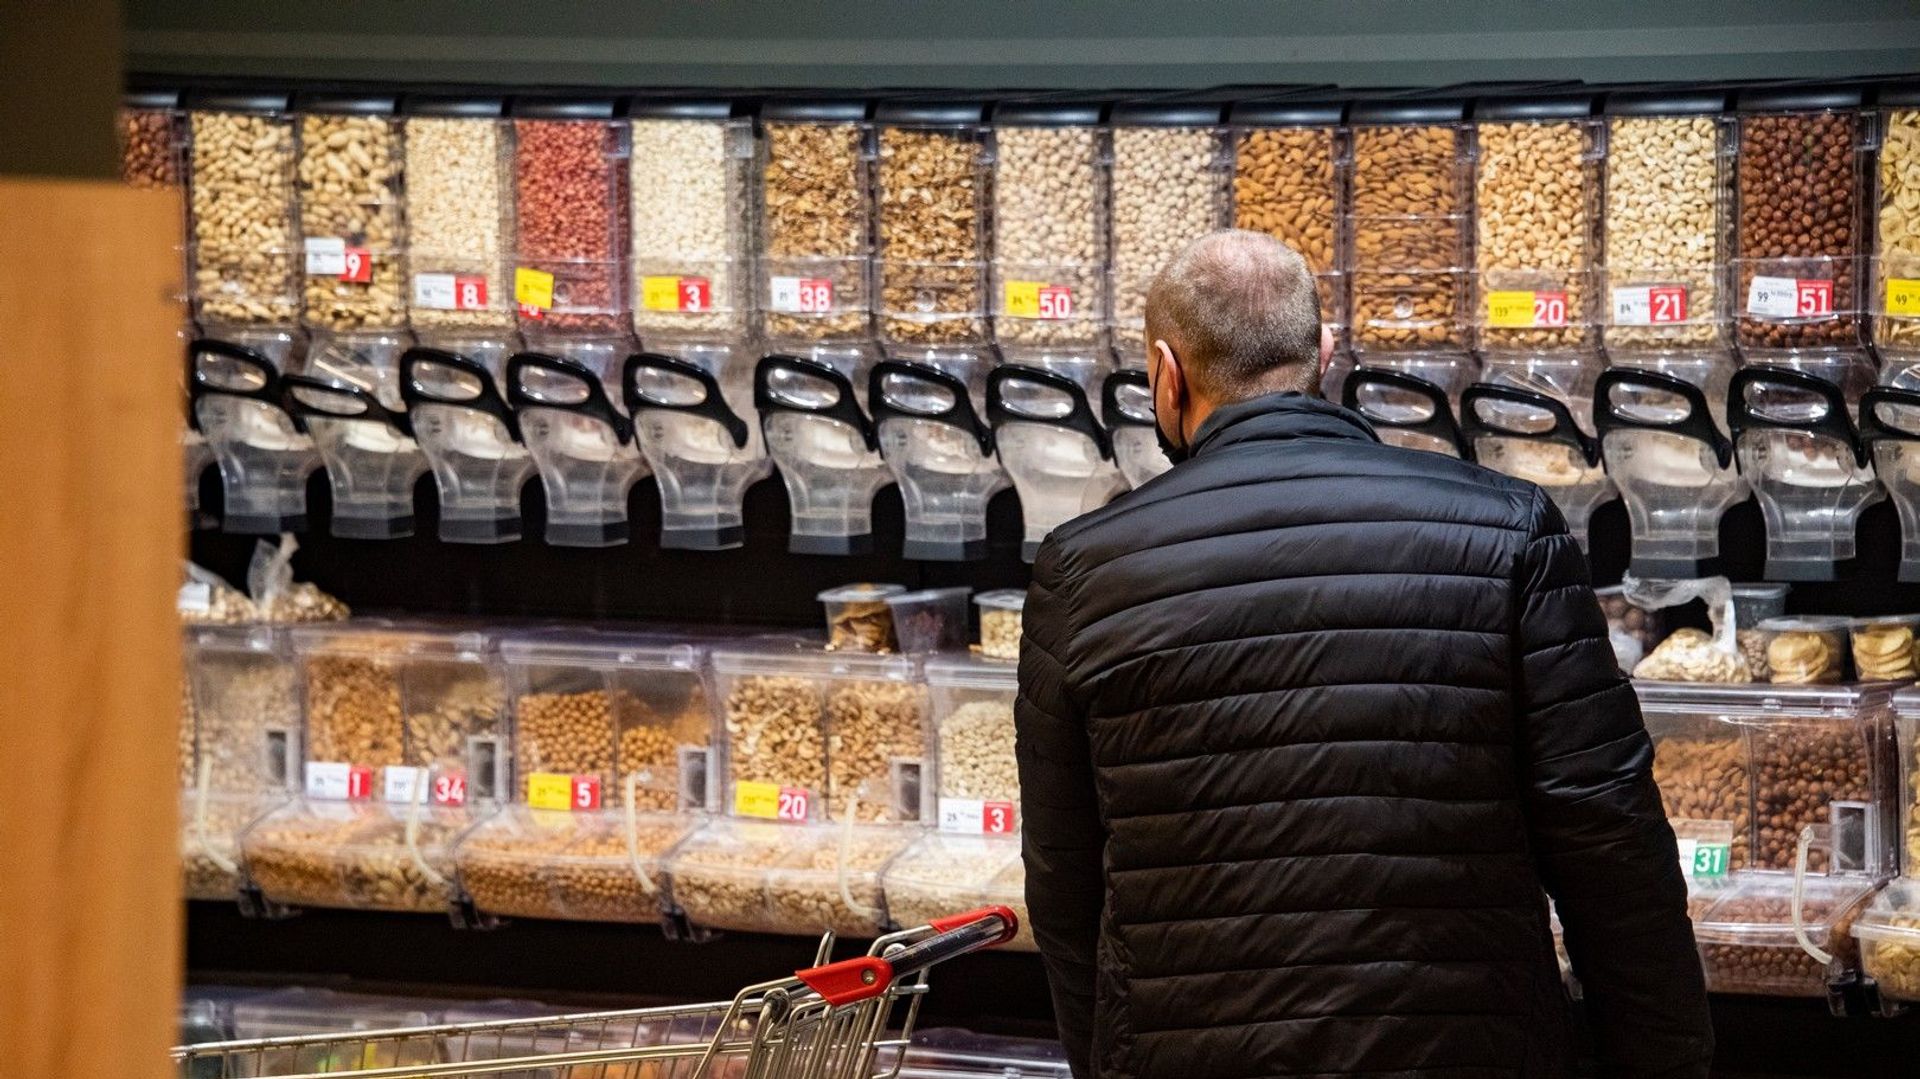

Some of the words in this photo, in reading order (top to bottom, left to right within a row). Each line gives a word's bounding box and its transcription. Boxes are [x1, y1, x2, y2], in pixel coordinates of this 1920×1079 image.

[346, 252, 361, 279] 9
[462, 283, 478, 308] 8
[685, 285, 701, 313] 3
[800, 286, 830, 312] 38
[1040, 292, 1071, 319] 50
[1655, 294, 1681, 320] 21
[1801, 287, 1829, 314] 51
[1534, 299, 1564, 325] 20
[352, 772, 361, 798] 1
[436, 776, 464, 802] 34
[577, 782, 592, 808] 5
[779, 793, 807, 820] 20
[990, 807, 1005, 833] 3
[1695, 847, 1721, 873] 31
